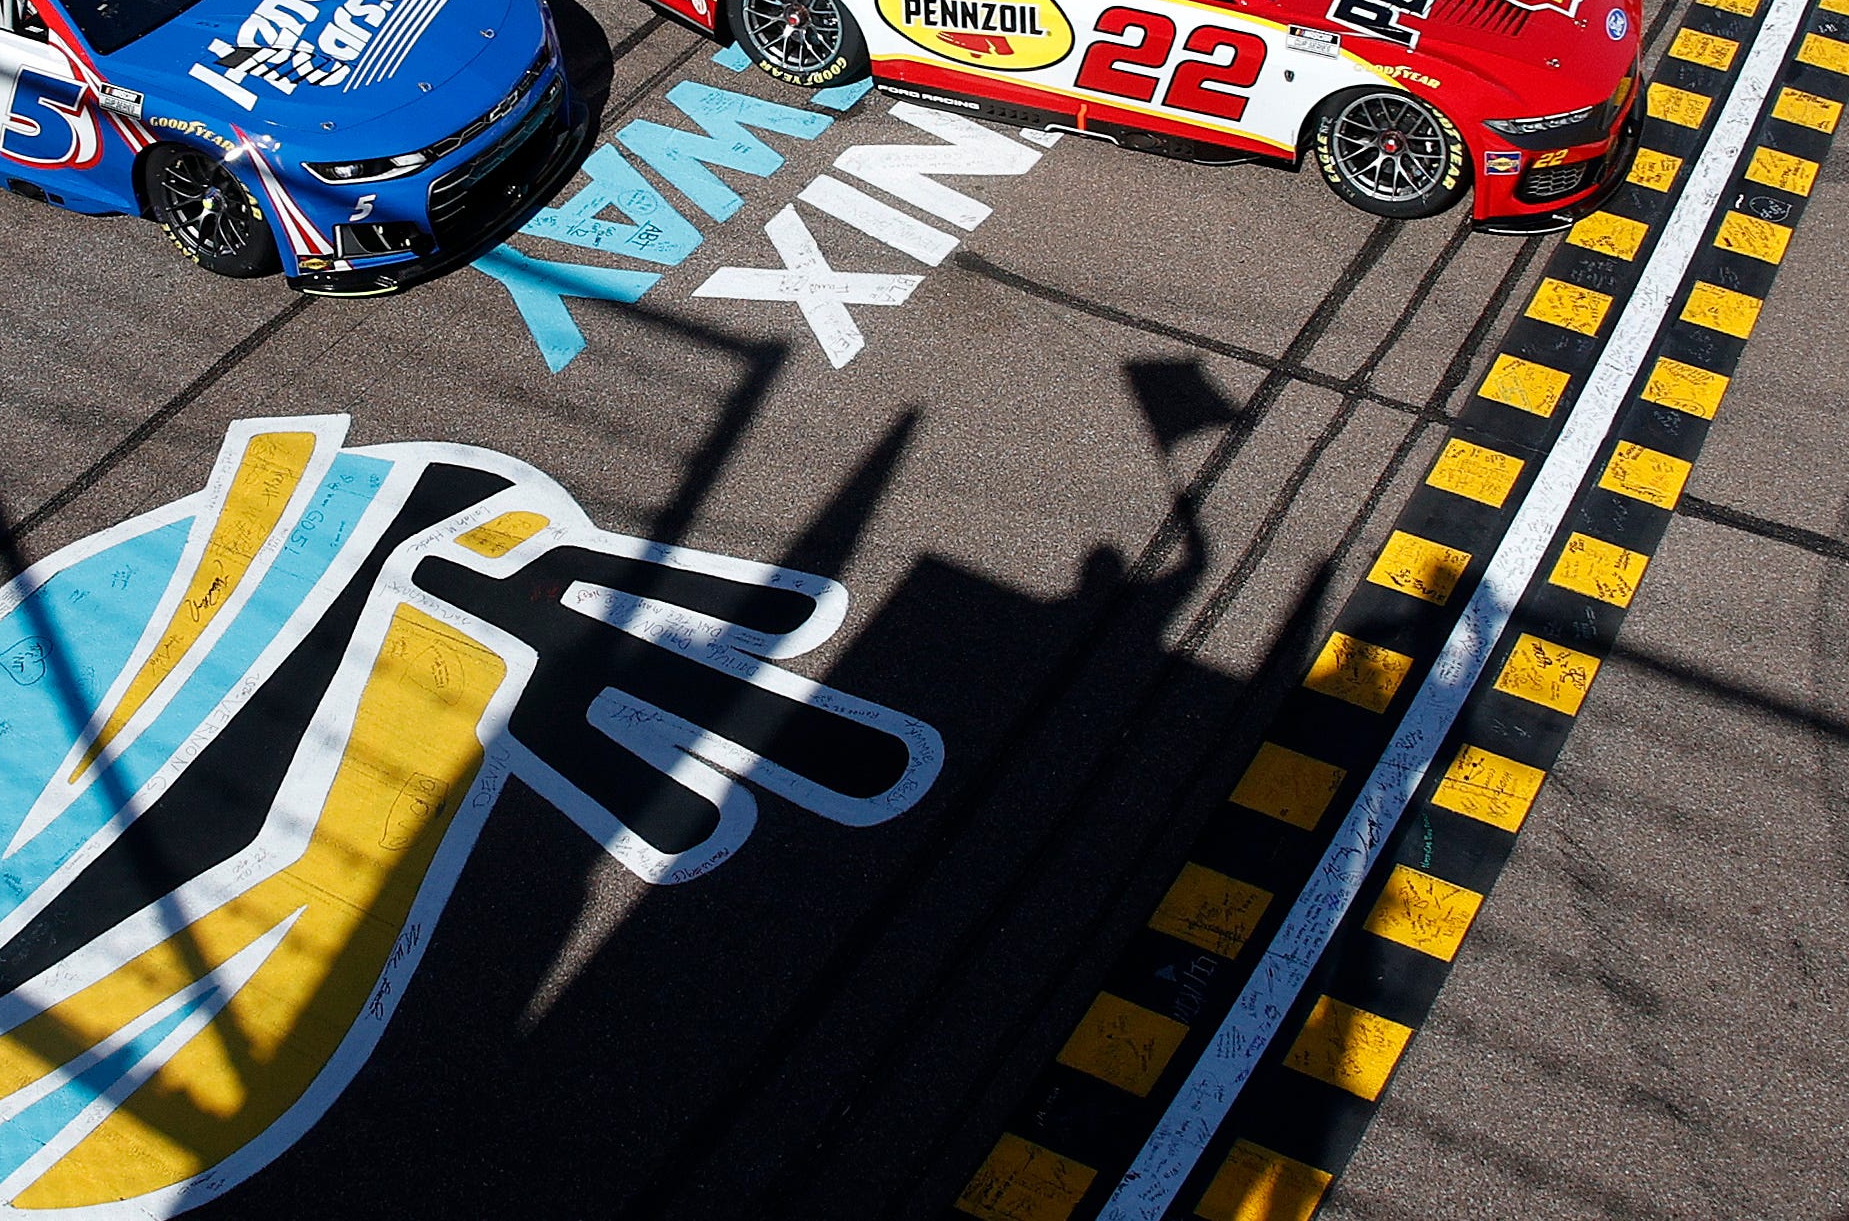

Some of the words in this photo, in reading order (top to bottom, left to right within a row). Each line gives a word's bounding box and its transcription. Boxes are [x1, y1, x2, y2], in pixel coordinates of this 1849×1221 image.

[758, 55, 848, 89] GOODYEAR
[1073, 5, 1268, 123] 22
[1353, 62, 1441, 89] GOODYEAR
[876, 83, 921, 100] FORD
[920, 92, 981, 111] RACING
[0, 66, 90, 165] 5
[149, 116, 235, 152] GOODYEAR
[1316, 133, 1342, 184] EAGLE
[1531, 148, 1570, 170] 22
[349, 194, 377, 222] 5
